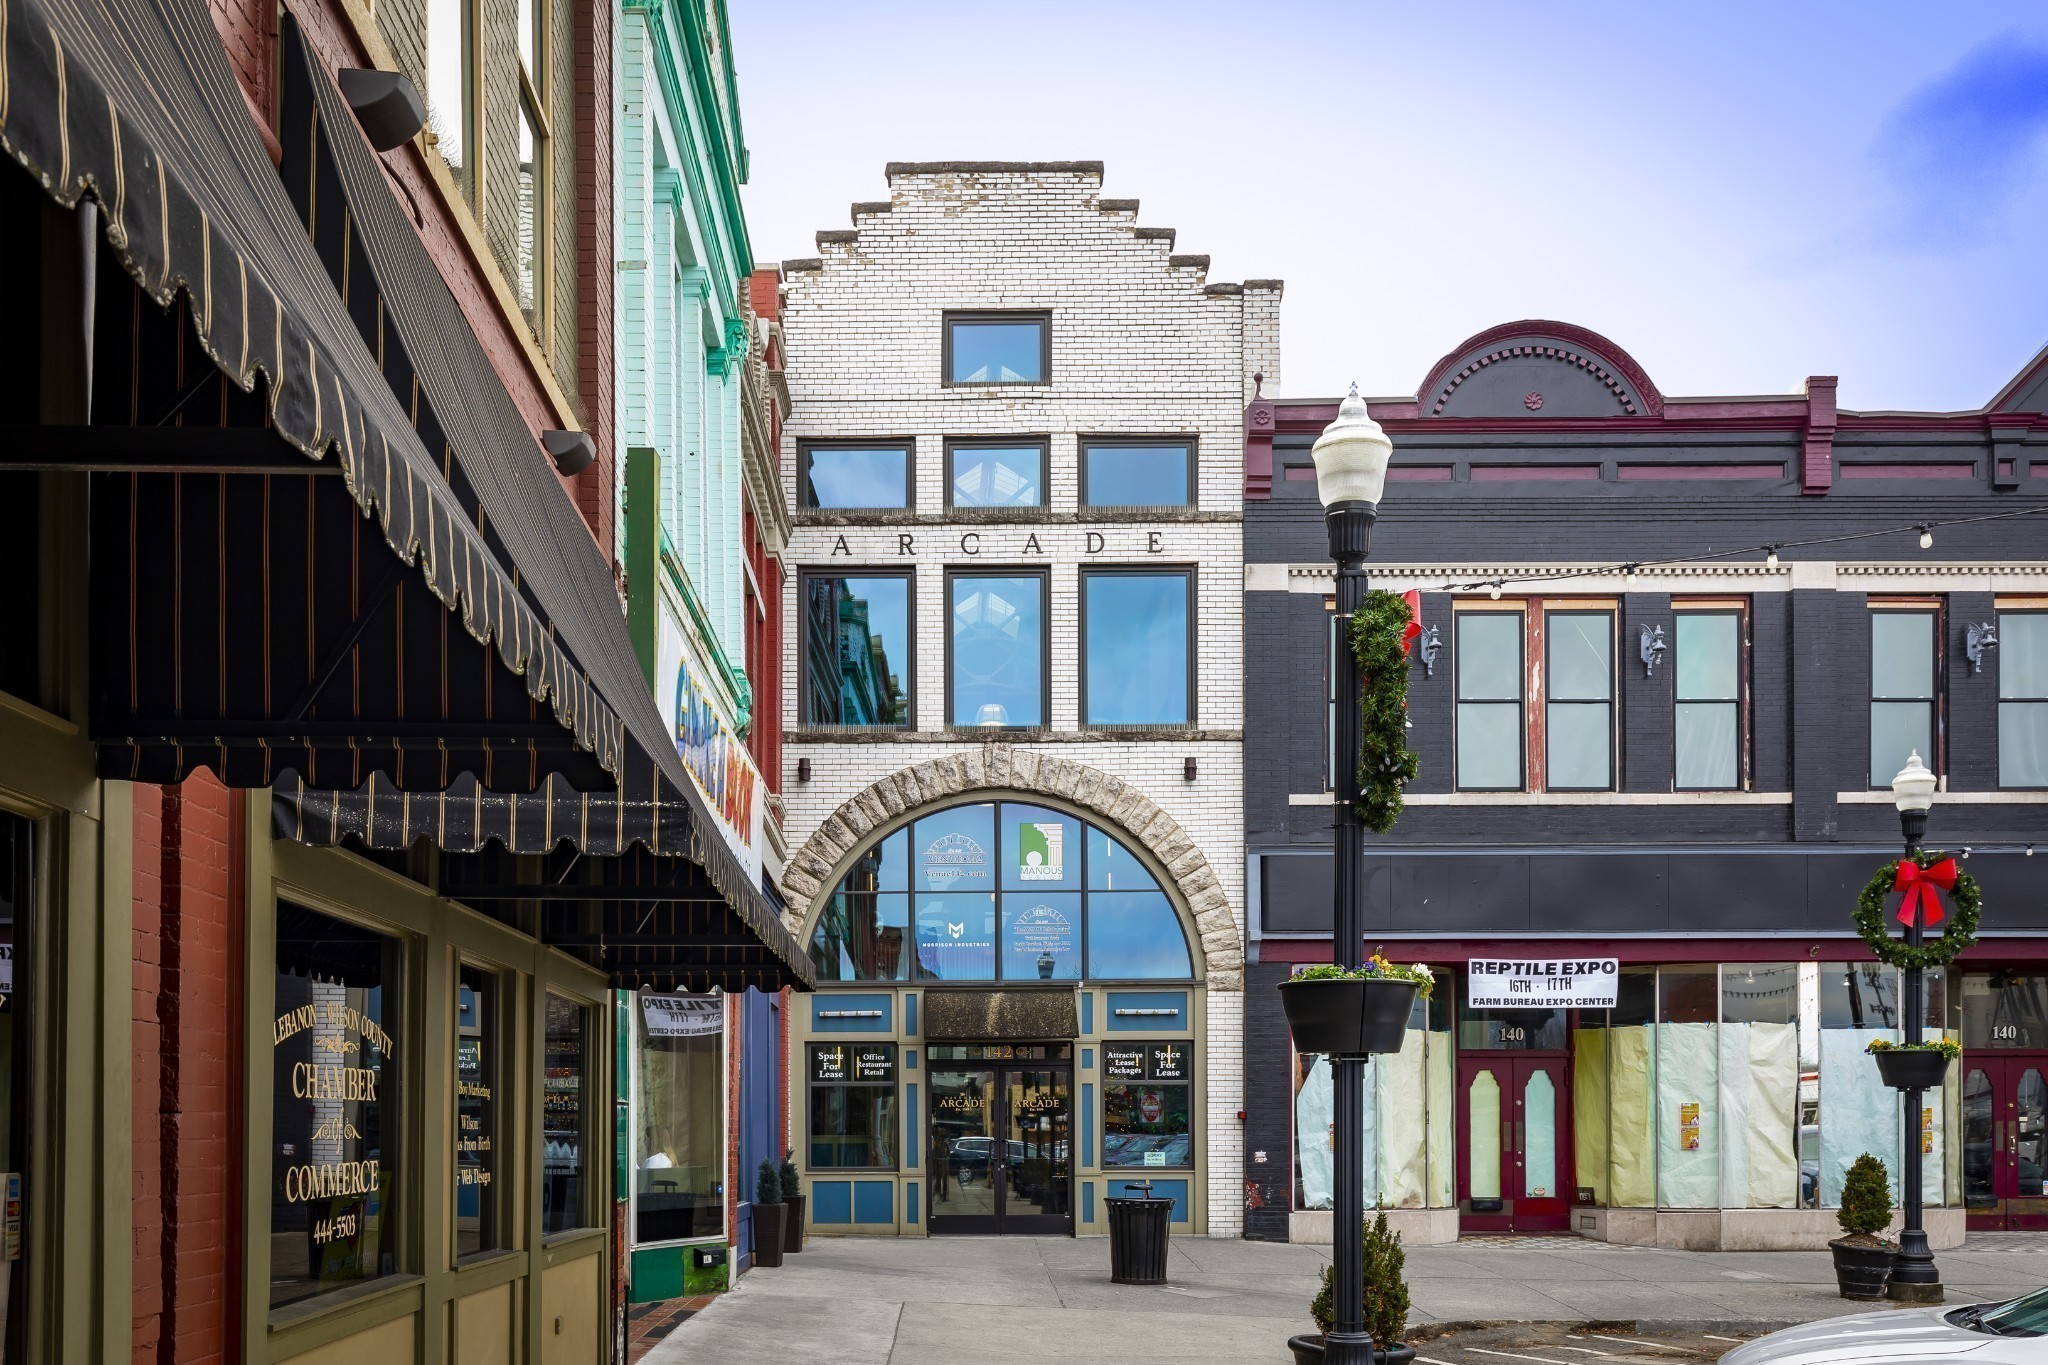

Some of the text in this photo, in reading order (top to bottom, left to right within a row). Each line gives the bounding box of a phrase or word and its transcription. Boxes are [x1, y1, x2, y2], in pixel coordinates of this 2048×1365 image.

[831, 531, 1163, 556] ARCADE
[1020, 866, 1063, 875] MANOUS
[1471, 960, 1616, 976] REPTILE EXPO
[1509, 979, 1532, 993] 16TH
[1547, 977, 1572, 991] 17TH
[1472, 997, 1614, 1006] FARM BUREAU EXPO CENTER
[360, 1015, 393, 1060] COUNTY
[1499, 1027, 1524, 1041] 140
[1992, 1026, 2017, 1039] 140
[818, 1052, 844, 1062] Space
[986, 1045, 1012, 1058] 142
[1155, 1050, 1181, 1060] Space
[1108, 1066, 1142, 1076] Packages
[1156, 1068, 1180, 1076] Lease
[292, 1061, 377, 1102] CHAMBER
[940, 1100, 985, 1108] ARCADE
[1014, 1100, 1060, 1108] ARCADE
[286, 1160, 379, 1203] COMMERCE
[314, 1214, 356, 1245] 444-5503
